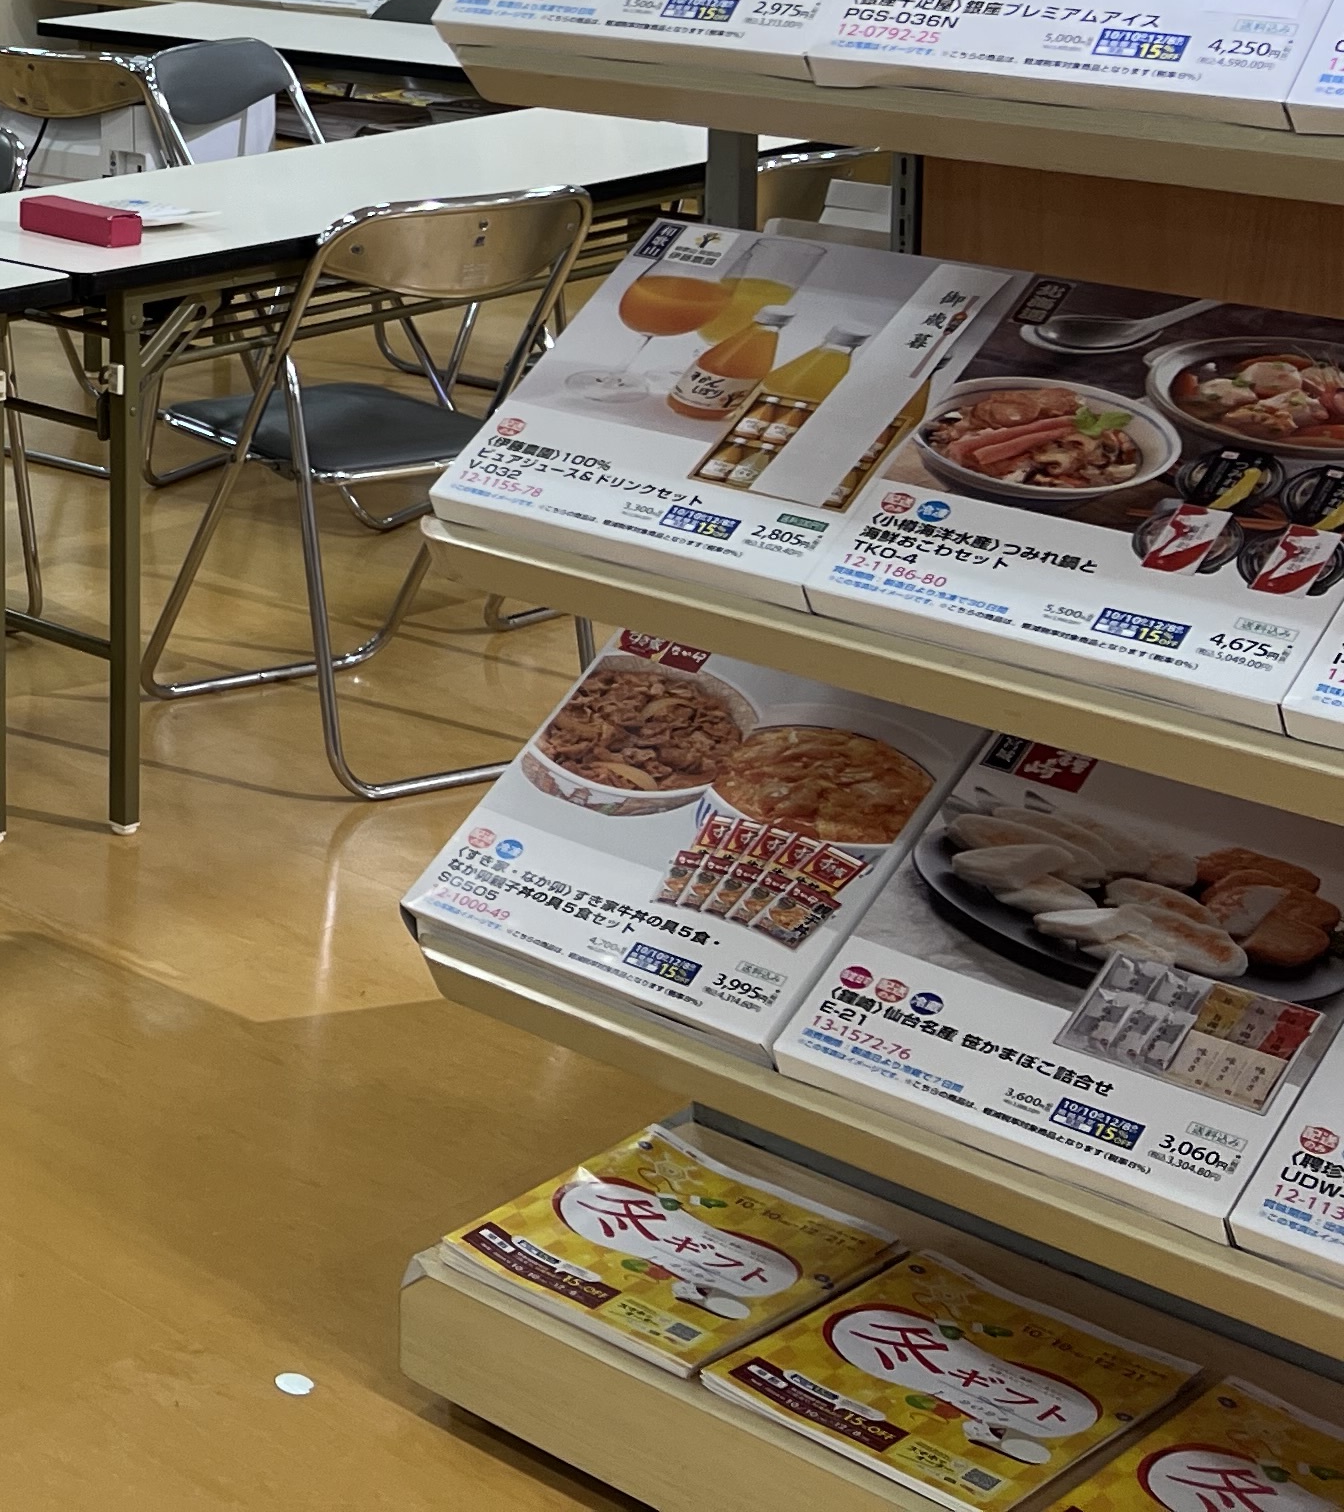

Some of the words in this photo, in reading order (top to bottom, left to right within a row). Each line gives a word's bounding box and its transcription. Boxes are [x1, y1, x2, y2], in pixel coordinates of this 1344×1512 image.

[843, 6, 961, 29] PGS-036N
[837, 22, 941, 44] 12-0792-25
[459, 470, 544, 498] 12-1155-78
[469, 459, 523, 481] V-032
[853, 539, 917, 565] TKO-4
[858, 525, 1009, 570] 海鮮おこわセット
[842, 552, 948, 588] 12-1186-80
[432, 883, 511, 921] 2-1000-49
[819, 999, 868, 1027] E-21
[811, 1014, 912, 1061] 13-1572-76
